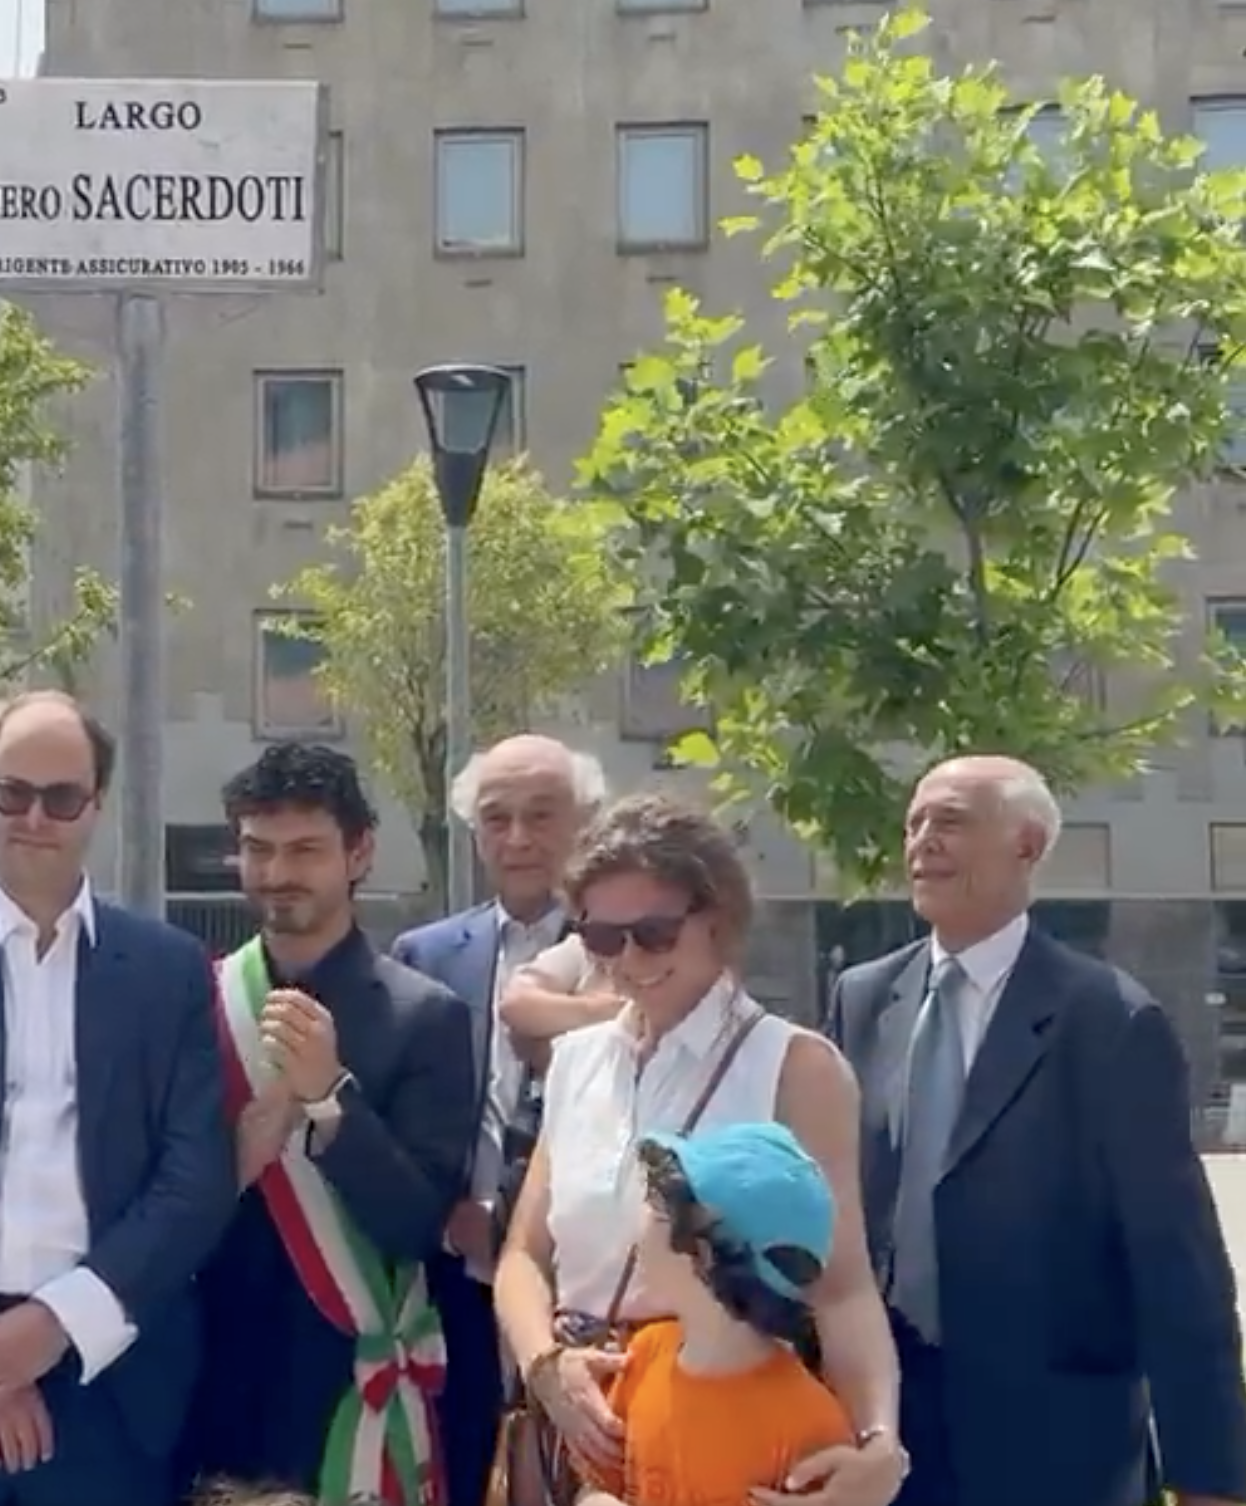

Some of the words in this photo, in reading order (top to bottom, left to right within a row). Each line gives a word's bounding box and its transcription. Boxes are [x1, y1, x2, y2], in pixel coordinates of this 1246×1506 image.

[75, 100, 202, 130] LARGO
[71, 174, 306, 222] SACERDOTI
[76, 258, 207, 275] ASSICURATIVO
[212, 259, 249, 275] 1905
[268, 259, 305, 275] 1966
